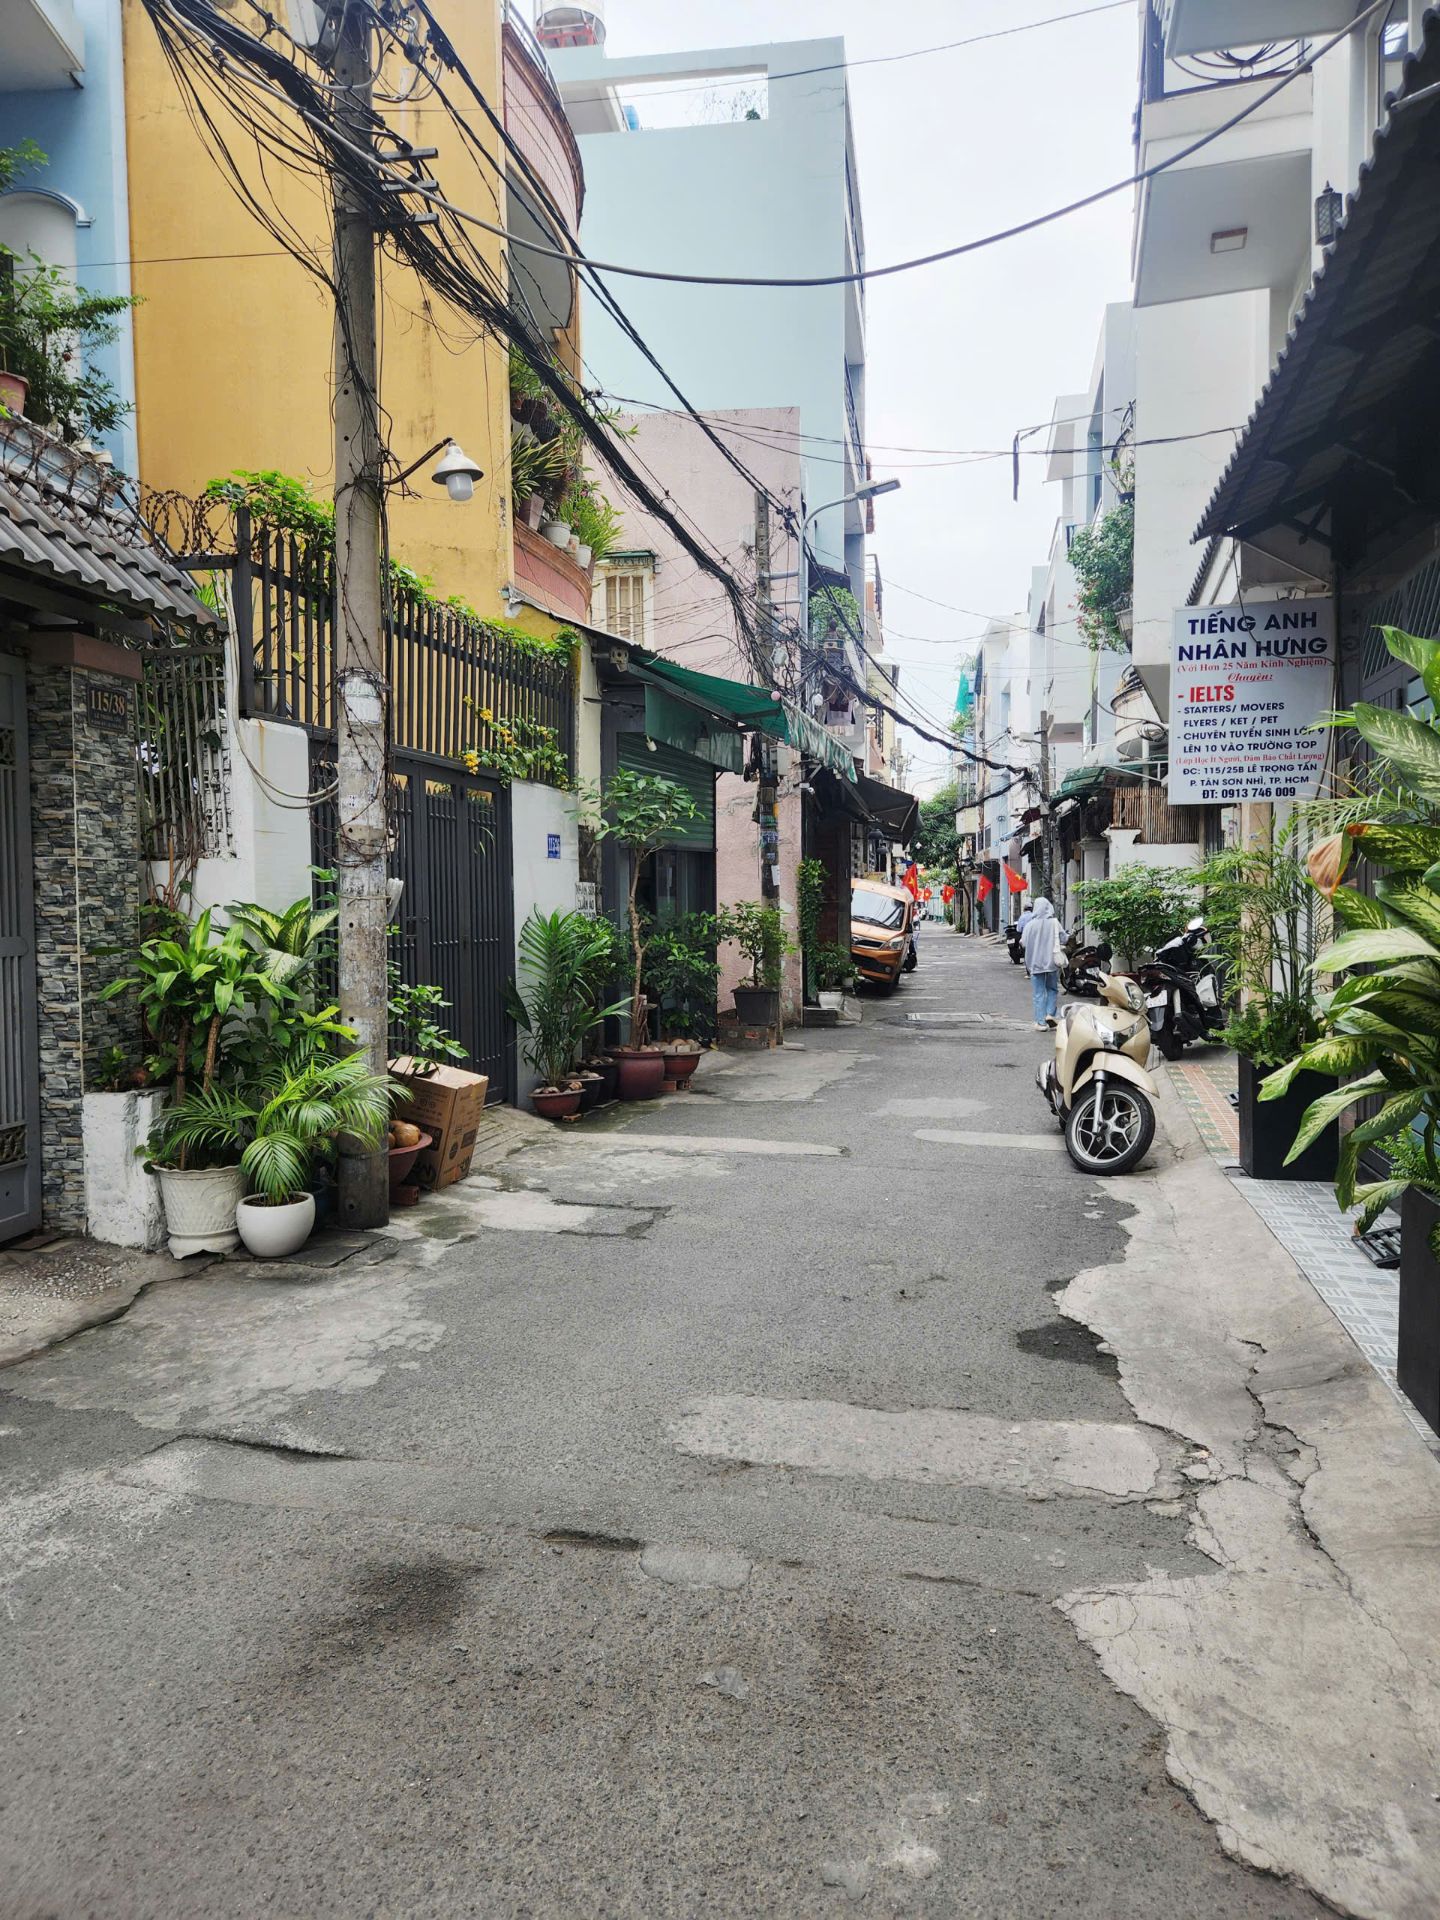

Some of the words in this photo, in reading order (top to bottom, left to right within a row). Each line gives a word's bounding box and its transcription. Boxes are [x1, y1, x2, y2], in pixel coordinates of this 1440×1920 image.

[1188, 610, 1256, 635] TIẾNG
[1264, 612, 1317, 630] ANH
[1179, 639, 1246, 661] NHÂN
[1256, 637, 1327, 656] HƯNG
[1223, 662, 1233, 670] 25
[1261, 658, 1283, 668] Kinh
[1190, 685, 1234, 703] IELTS
[91, 690, 125, 716] 115/38
[1184, 704, 1237, 714] STARTERS/
[1241, 703, 1284, 711] MOVERS
[1184, 719, 1217, 727] FLYERS
[1231, 717, 1248, 725] KET
[1261, 716, 1278, 724] PET
[1184, 730, 1226, 740] CHUYÊN
[1230, 726, 1262, 738] TUYỂN
[1265, 729, 1290, 737] SINH
[1318, 727, 1324, 735] 9
[1184, 744, 1200, 753] LÊN
[1206, 744, 1217, 752] 10
[1221, 742, 1244, 751] VÀO
[1248, 740, 1292, 750] TRƯỜNG
[1205, 766, 1244, 775] 115/25B
[1248, 763, 1257, 772] LÊ
[1261, 764, 1294, 773] TRỌNG
[1298, 761, 1317, 771] TẤN
[1201, 777, 1219, 786] TÂN
[1222, 776, 1242, 786] SƠN
[1246, 776, 1266, 786] NHÌ,
[1203, 789, 1218, 799] ĐT:
[1222, 788, 1248, 798] 0913
[1252, 787, 1271, 797] 746
[1276, 787, 1296, 797] 009
